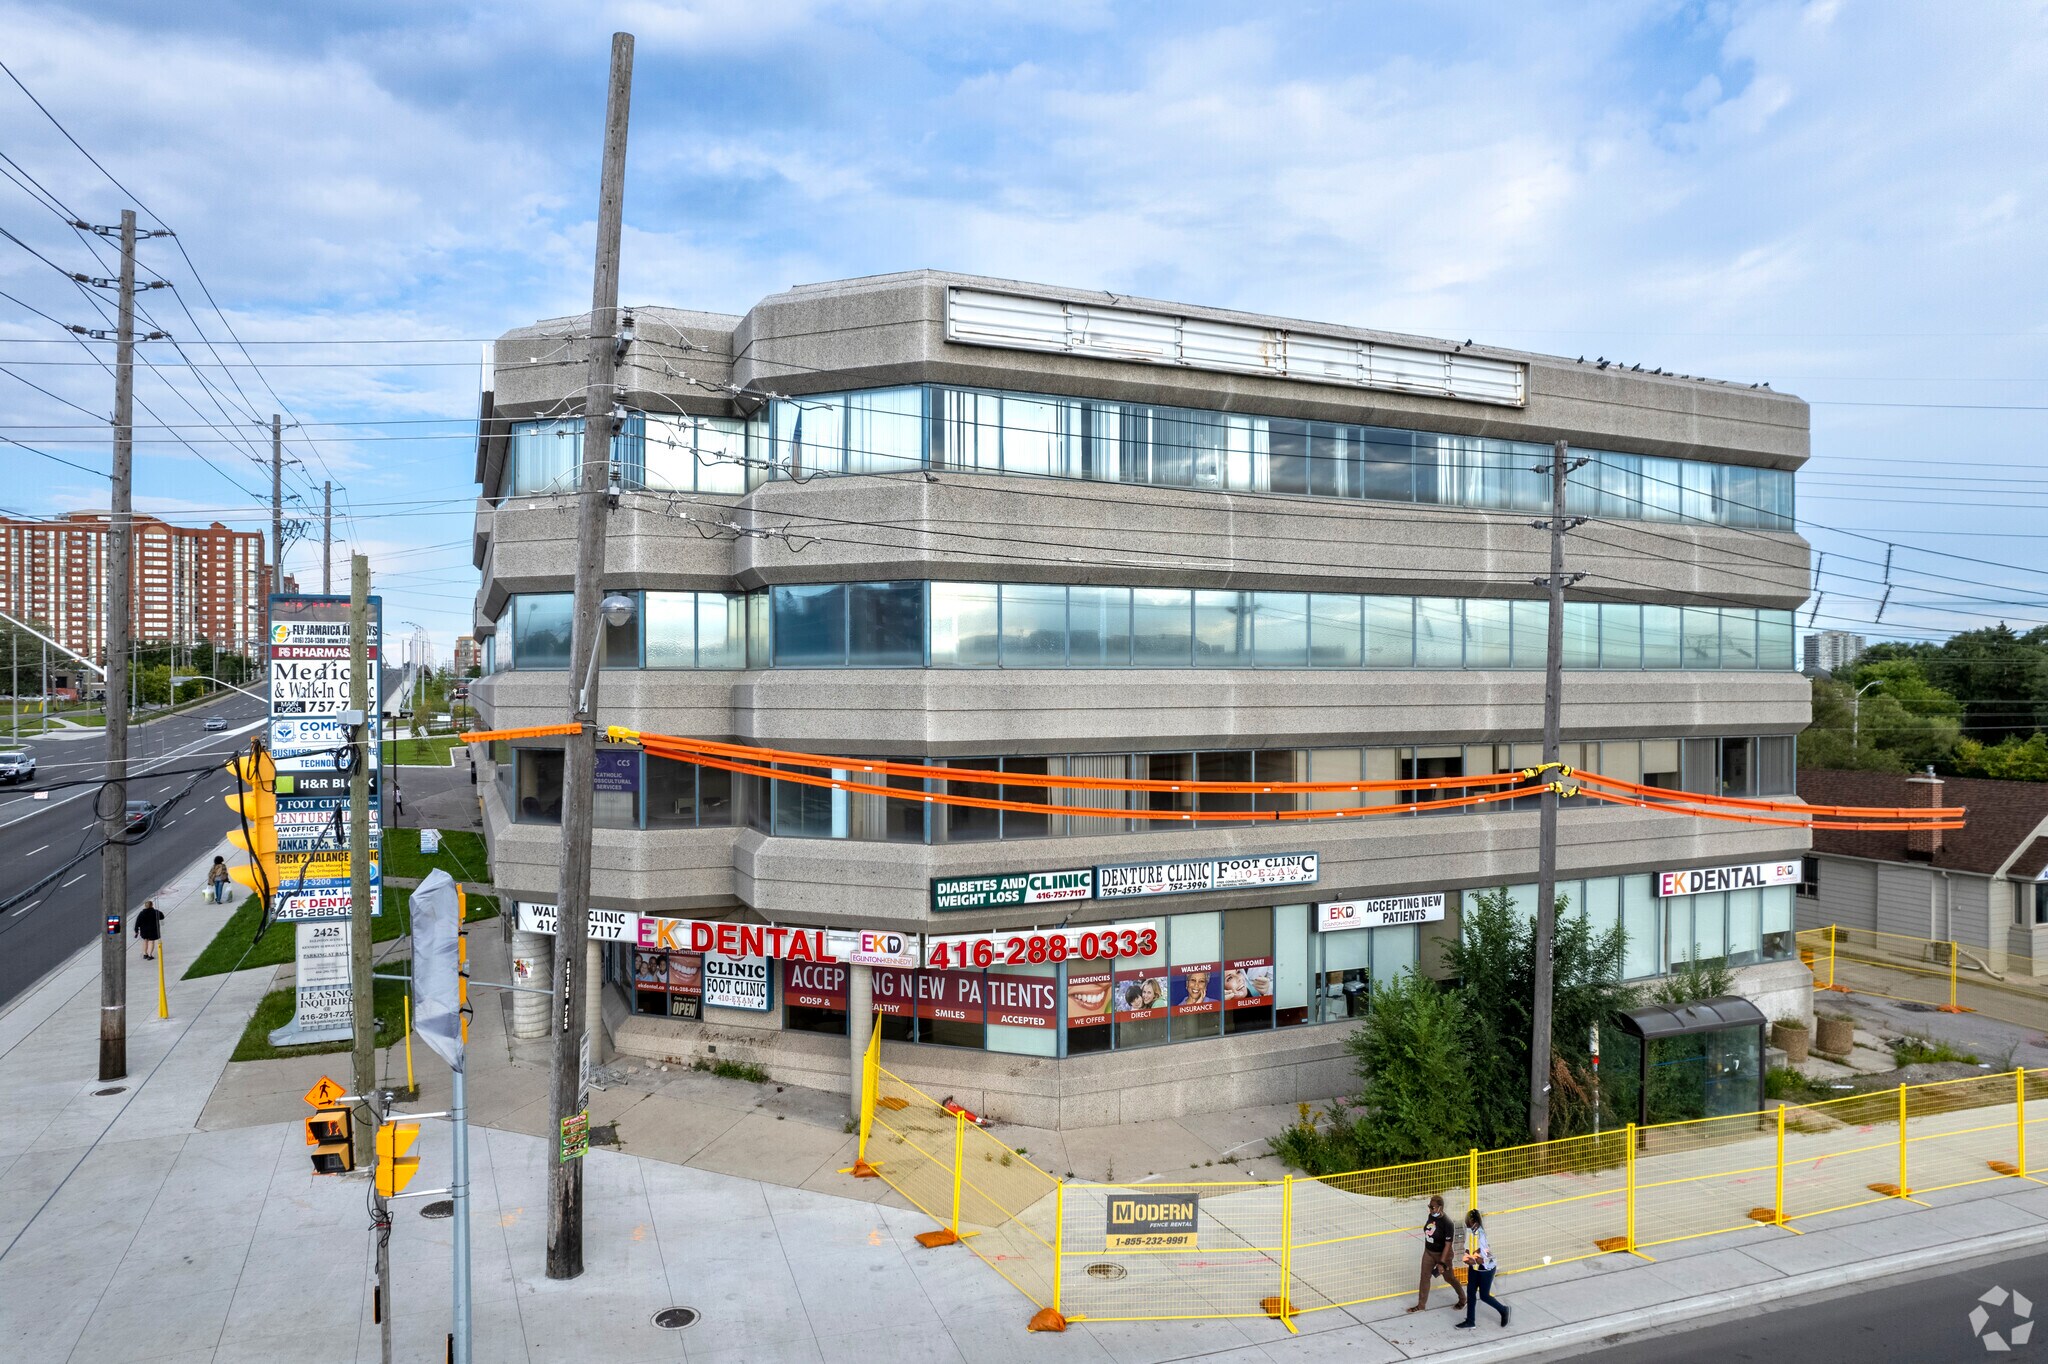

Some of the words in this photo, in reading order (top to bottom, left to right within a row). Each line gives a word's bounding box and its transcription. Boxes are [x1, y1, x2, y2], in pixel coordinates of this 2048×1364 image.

[293, 625, 304, 635] FLY
[306, 625, 341, 635] JAMAICA
[274, 662, 374, 680] Medicl
[275, 682, 284, 698] &
[289, 682, 334, 698] Walk-In
[309, 701, 376, 712] 757-77
[300, 780, 328, 789] H&R
[288, 800, 315, 809] FOOT
[301, 853, 307, 863] 2
[1028, 872, 1091, 891] CLINIC
[1101, 865, 1163, 887] DENTURE
[1167, 862, 1210, 882] CLINIC
[1662, 871, 1687, 895] EK
[1690, 865, 1766, 893] DENTAL
[937, 878, 998, 895] DIABETES
[1001, 877, 1027, 890] AND
[1036, 889, 1087, 900] 416-757-7117
[1102, 885, 1142, 896] 759-4535
[1168, 881, 1208, 891] 752-3996
[290, 900, 306, 909] EK
[309, 898, 352, 908] DENTA
[937, 893, 987, 907] WEIGHT
[989, 890, 1020, 903] LOSS
[1366, 897, 1420, 913] ACCEPTING
[1421, 895, 1442, 907] NEW
[588, 911, 626, 925] CLINIC
[1330, 906, 1355, 920] EKD
[1382, 909, 1426, 924] PATIENTS
[313, 927, 340, 937] 2425
[637, 918, 681, 951] EK
[690, 922, 838, 964] DENTAL
[861, 934, 902, 954] EKD
[928, 928, 1158, 970] 416-288-0333
[706, 961, 765, 978] CLINIC
[1069, 974, 1111, 985] EMERGENCIES
[1181, 964, 1212, 973] WALK-INS
[1233, 959, 1265, 968] WELCOME!
[707, 978, 732, 994] FOOT
[734, 981, 765, 998] CLINIC
[672, 1002, 696, 1017] OPEN
[800, 996, 822, 1005] ODSP
[935, 1009, 965, 1019] SMILES
[1001, 1015, 1045, 1026] ACCEPTED
[1086, 1016, 1105, 1024] OFFER
[1130, 1010, 1152, 1019] DIRECT
[1179, 1004, 1213, 1013] INSURANCE
[1237, 999, 1261, 1007] BILLING!
[1112, 1201, 1194, 1224] MODERN
[1115, 1236, 1188, 1246] 1-855-232-9991
